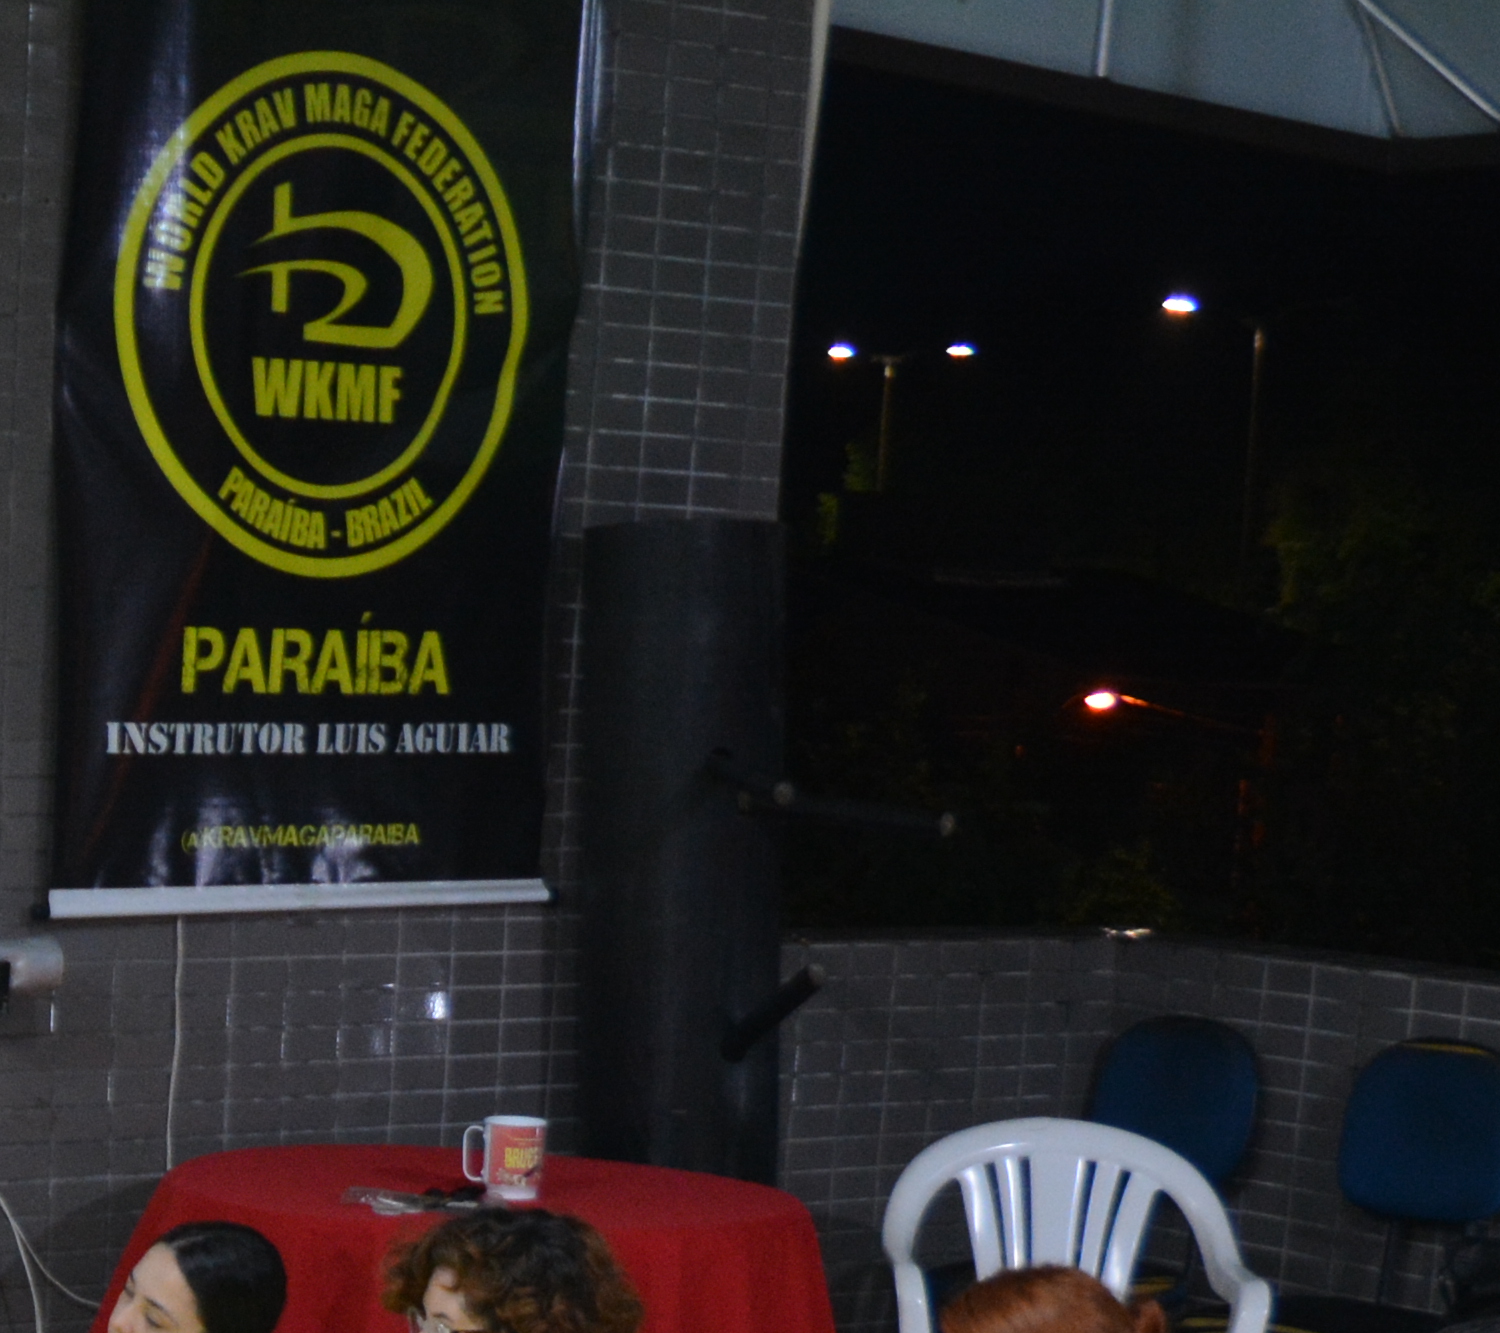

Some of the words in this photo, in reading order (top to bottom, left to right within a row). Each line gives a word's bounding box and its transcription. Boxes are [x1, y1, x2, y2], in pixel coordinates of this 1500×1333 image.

[141, 152, 224, 292] WORLD
[218, 85, 298, 168] KRAV
[304, 82, 389, 132] MAGA
[391, 108, 506, 317] FEDERATION
[252, 355, 403, 426] WKMF
[218, 465, 328, 551] PARAÍBA
[346, 476, 433, 551] BRAZIL
[181, 612, 451, 697] PARAÍBA
[105, 720, 307, 756] INSTRUTOR
[316, 722, 389, 754] LUIS
[395, 722, 512, 754] AGUIAR
